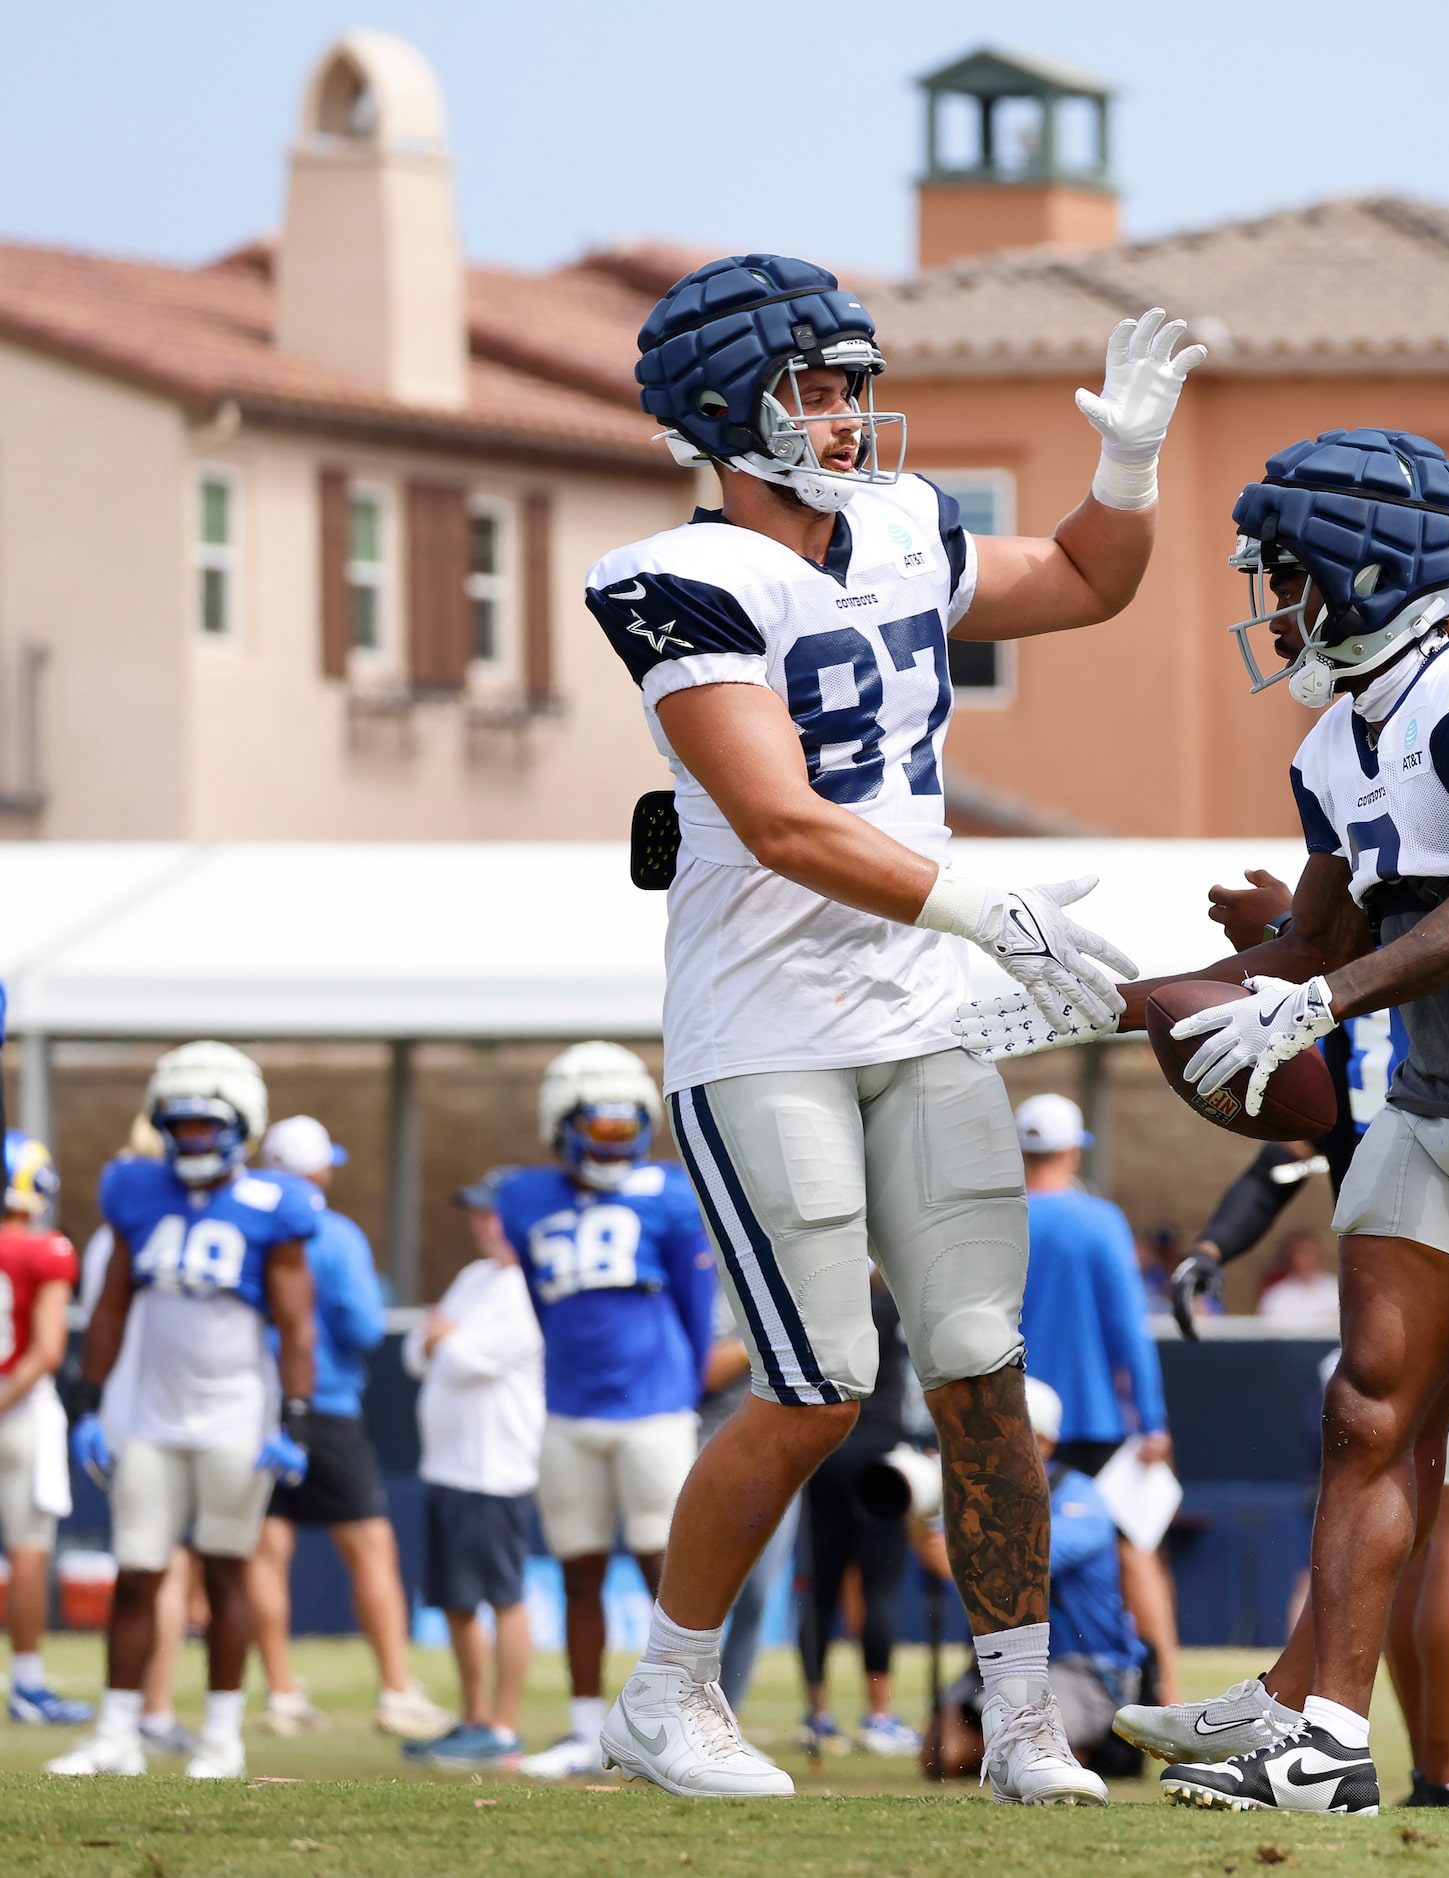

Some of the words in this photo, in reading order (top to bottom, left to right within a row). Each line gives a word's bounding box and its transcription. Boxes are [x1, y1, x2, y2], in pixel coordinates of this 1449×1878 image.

[903, 552, 925, 568] AT&T
[836, 594, 878, 609] COWBOYS
[785, 608, 951, 805] 87
[1402, 751, 1423, 772] AT&T
[136, 1214, 247, 1294] 48
[529, 1203, 641, 1304] 58
